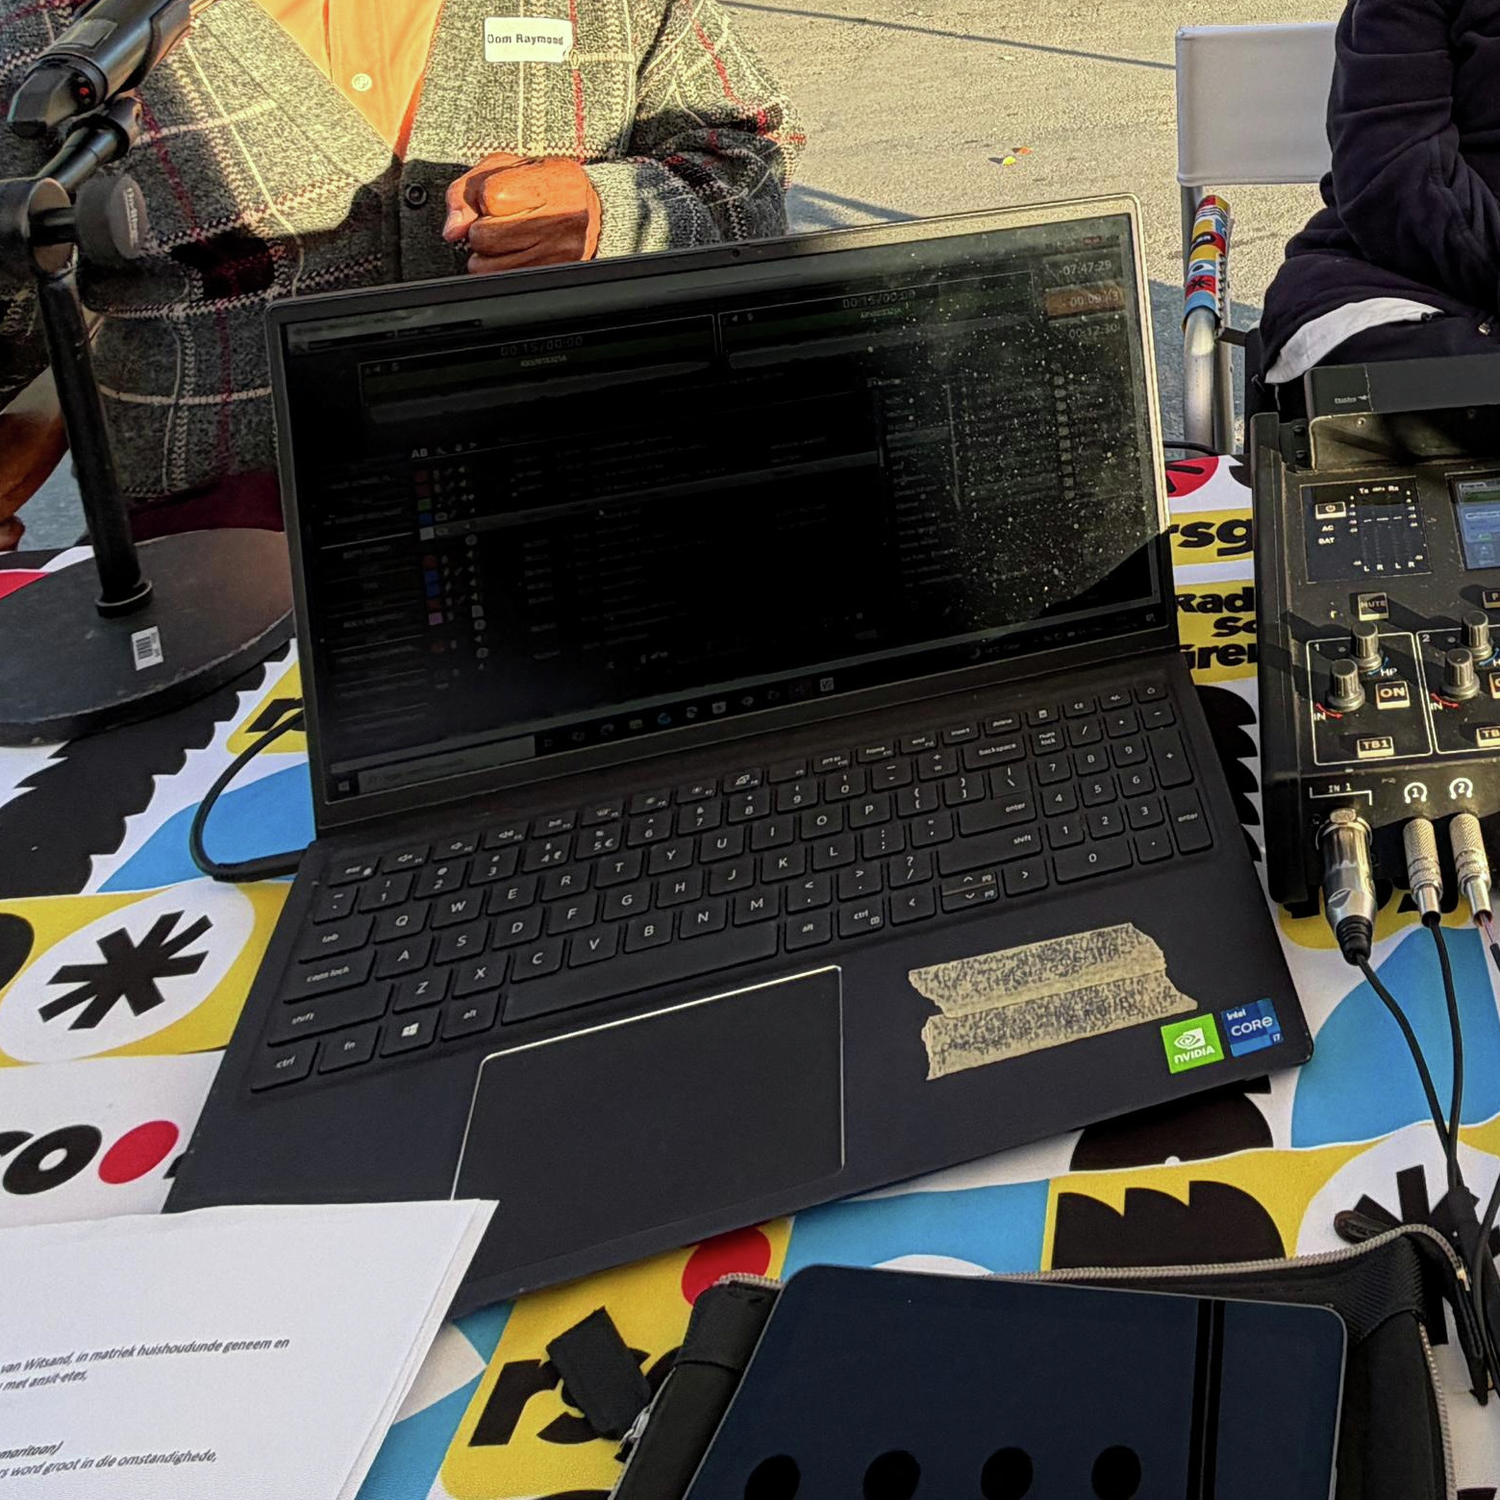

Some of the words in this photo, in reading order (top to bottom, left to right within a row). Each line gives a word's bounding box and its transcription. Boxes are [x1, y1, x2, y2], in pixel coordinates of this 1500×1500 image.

[516, 33, 564, 45] Raymond
[1318, 537, 1336, 545] BAT
[1360, 599, 1386, 609] MUTE
[1380, 687, 1405, 699] ON
[1362, 740, 1390, 749] TB1
[1328, 785, 1341, 793] IN
[75, 1352, 88, 1363] in
[90, 1347, 136, 1361] matriek
[224, 1340, 272, 1353] geneem
[274, 1338, 290, 1349] en
[3, 1378, 28, 1391] met
[10, 1461, 42, 1477] word
[42, 1459, 79, 1475] groot
[80, 1457, 94, 1469] in
[96, 1454, 117, 1468] die
[118, 1449, 217, 1467] omstandighede,
